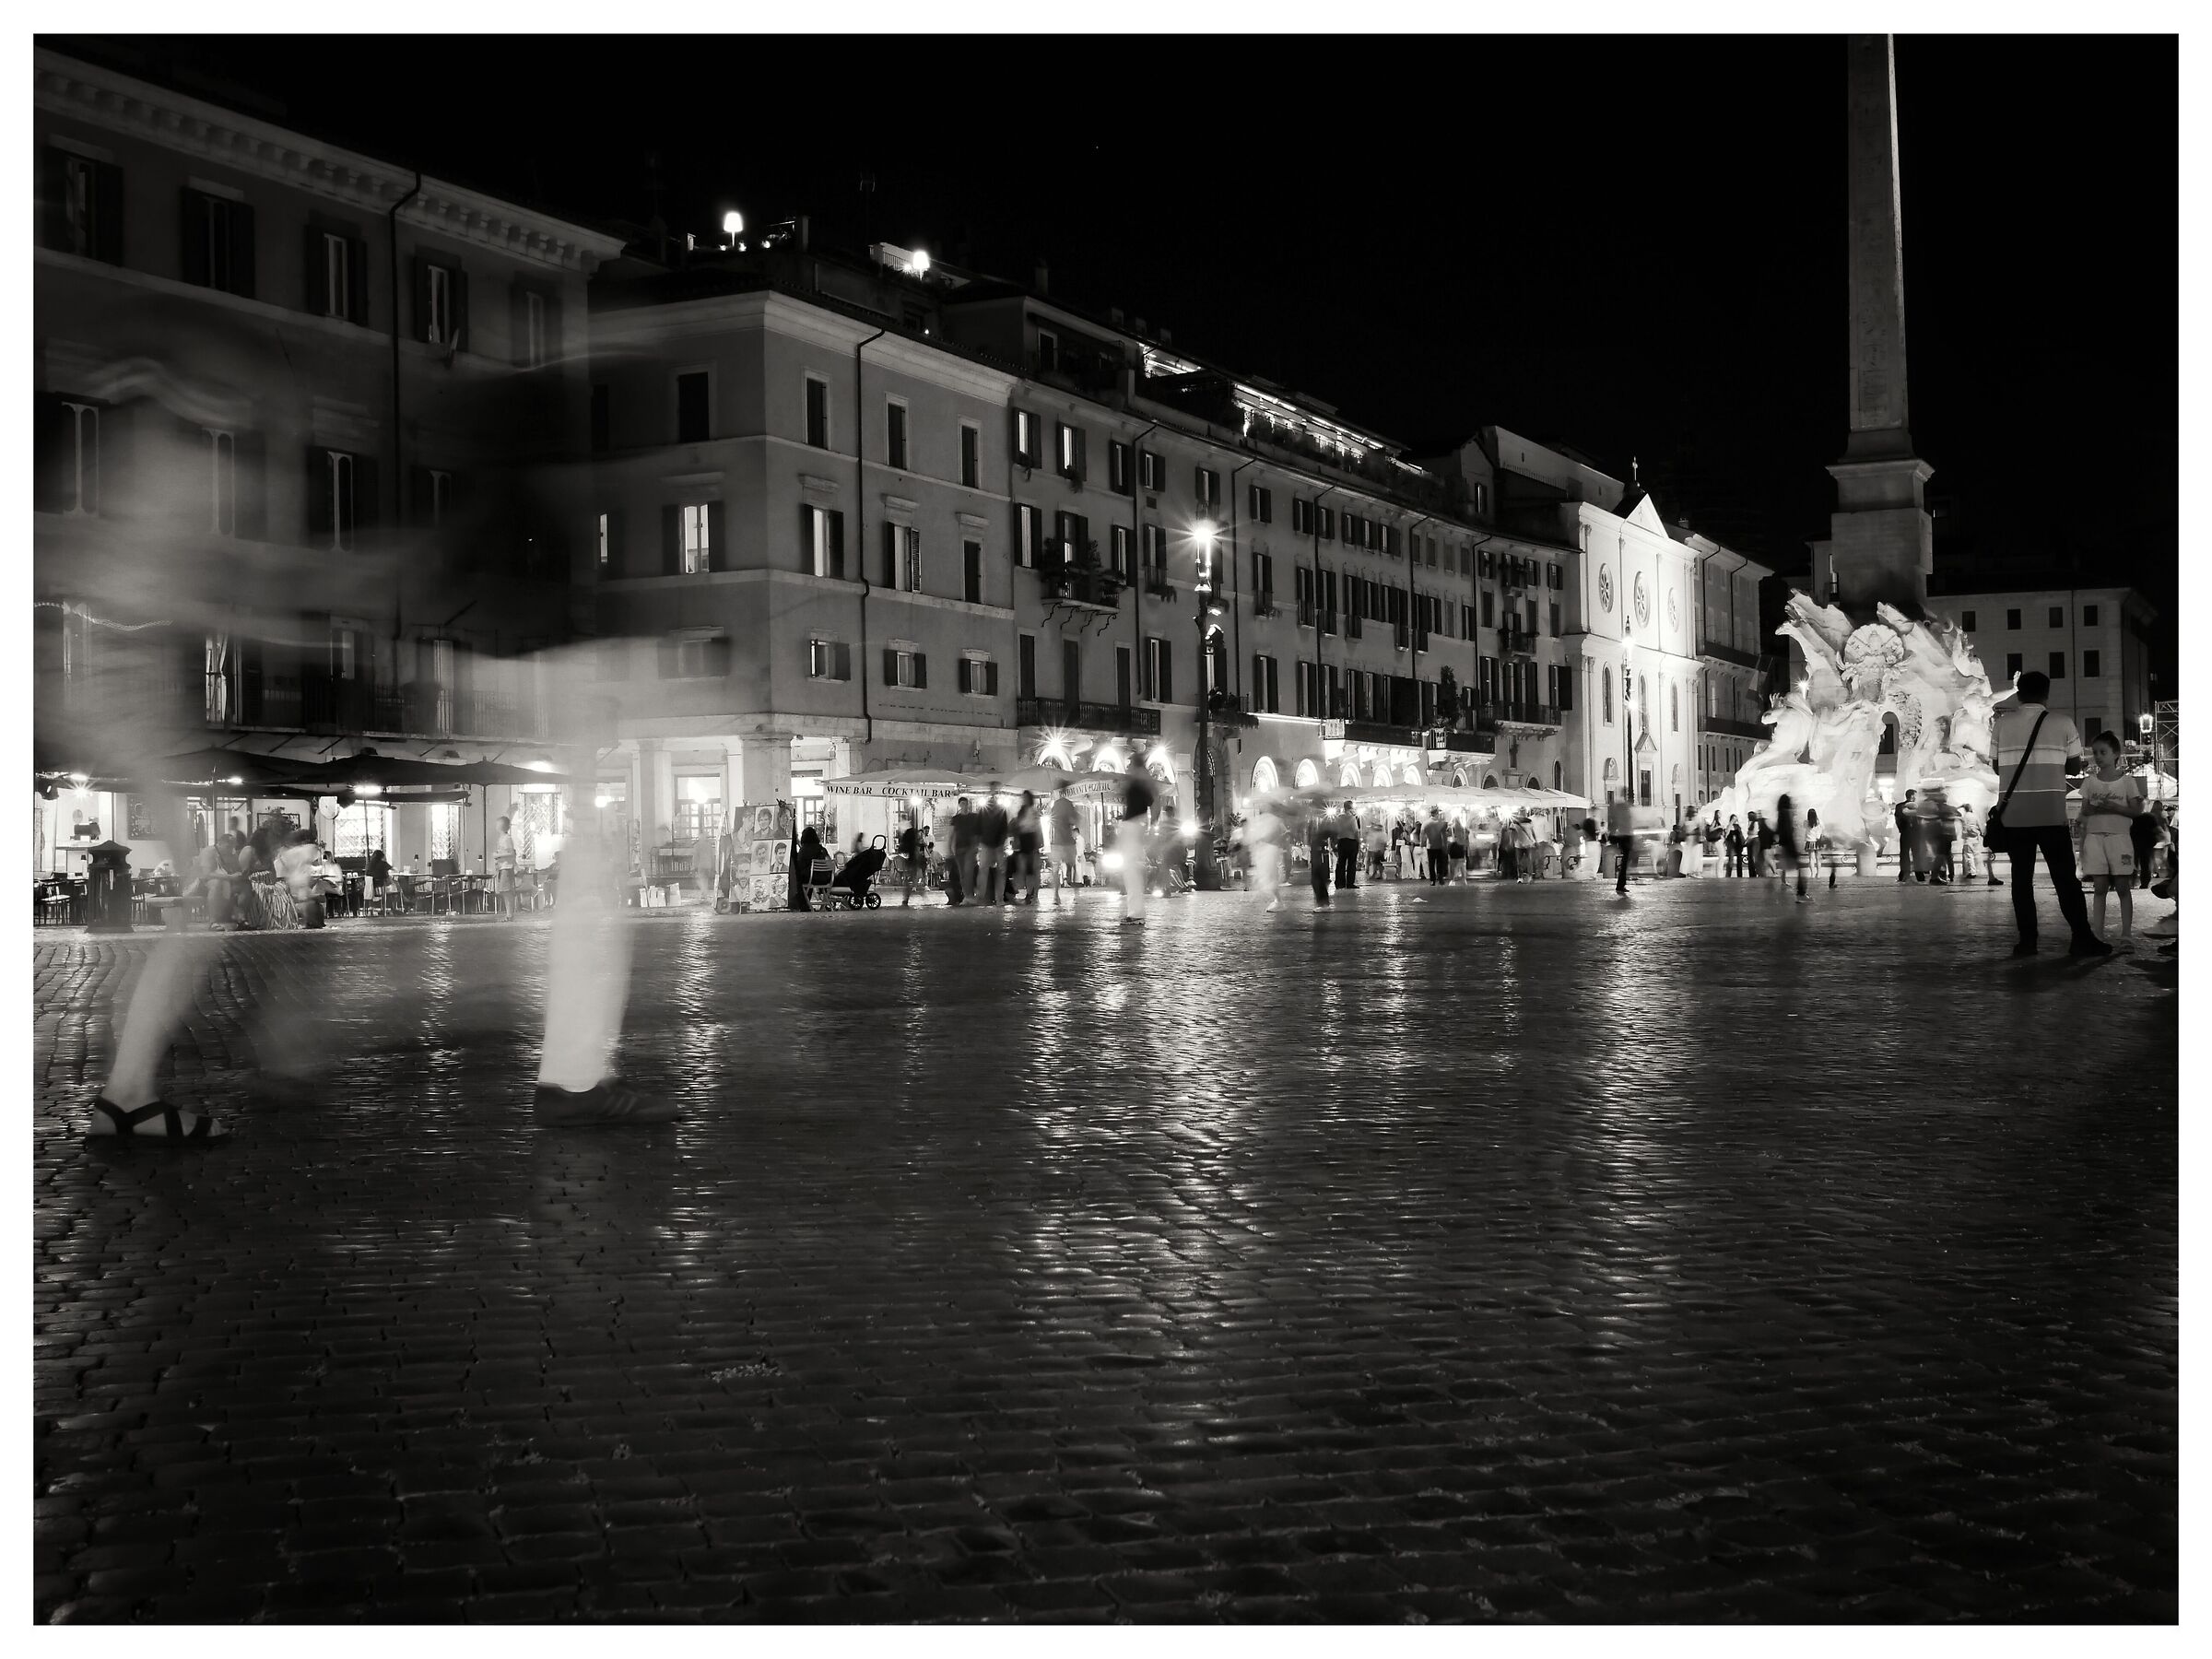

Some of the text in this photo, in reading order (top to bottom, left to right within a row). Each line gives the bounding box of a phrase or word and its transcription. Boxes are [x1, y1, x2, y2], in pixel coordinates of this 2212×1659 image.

[827, 785, 952, 798] WINE BAR COCKTAIL BAR
